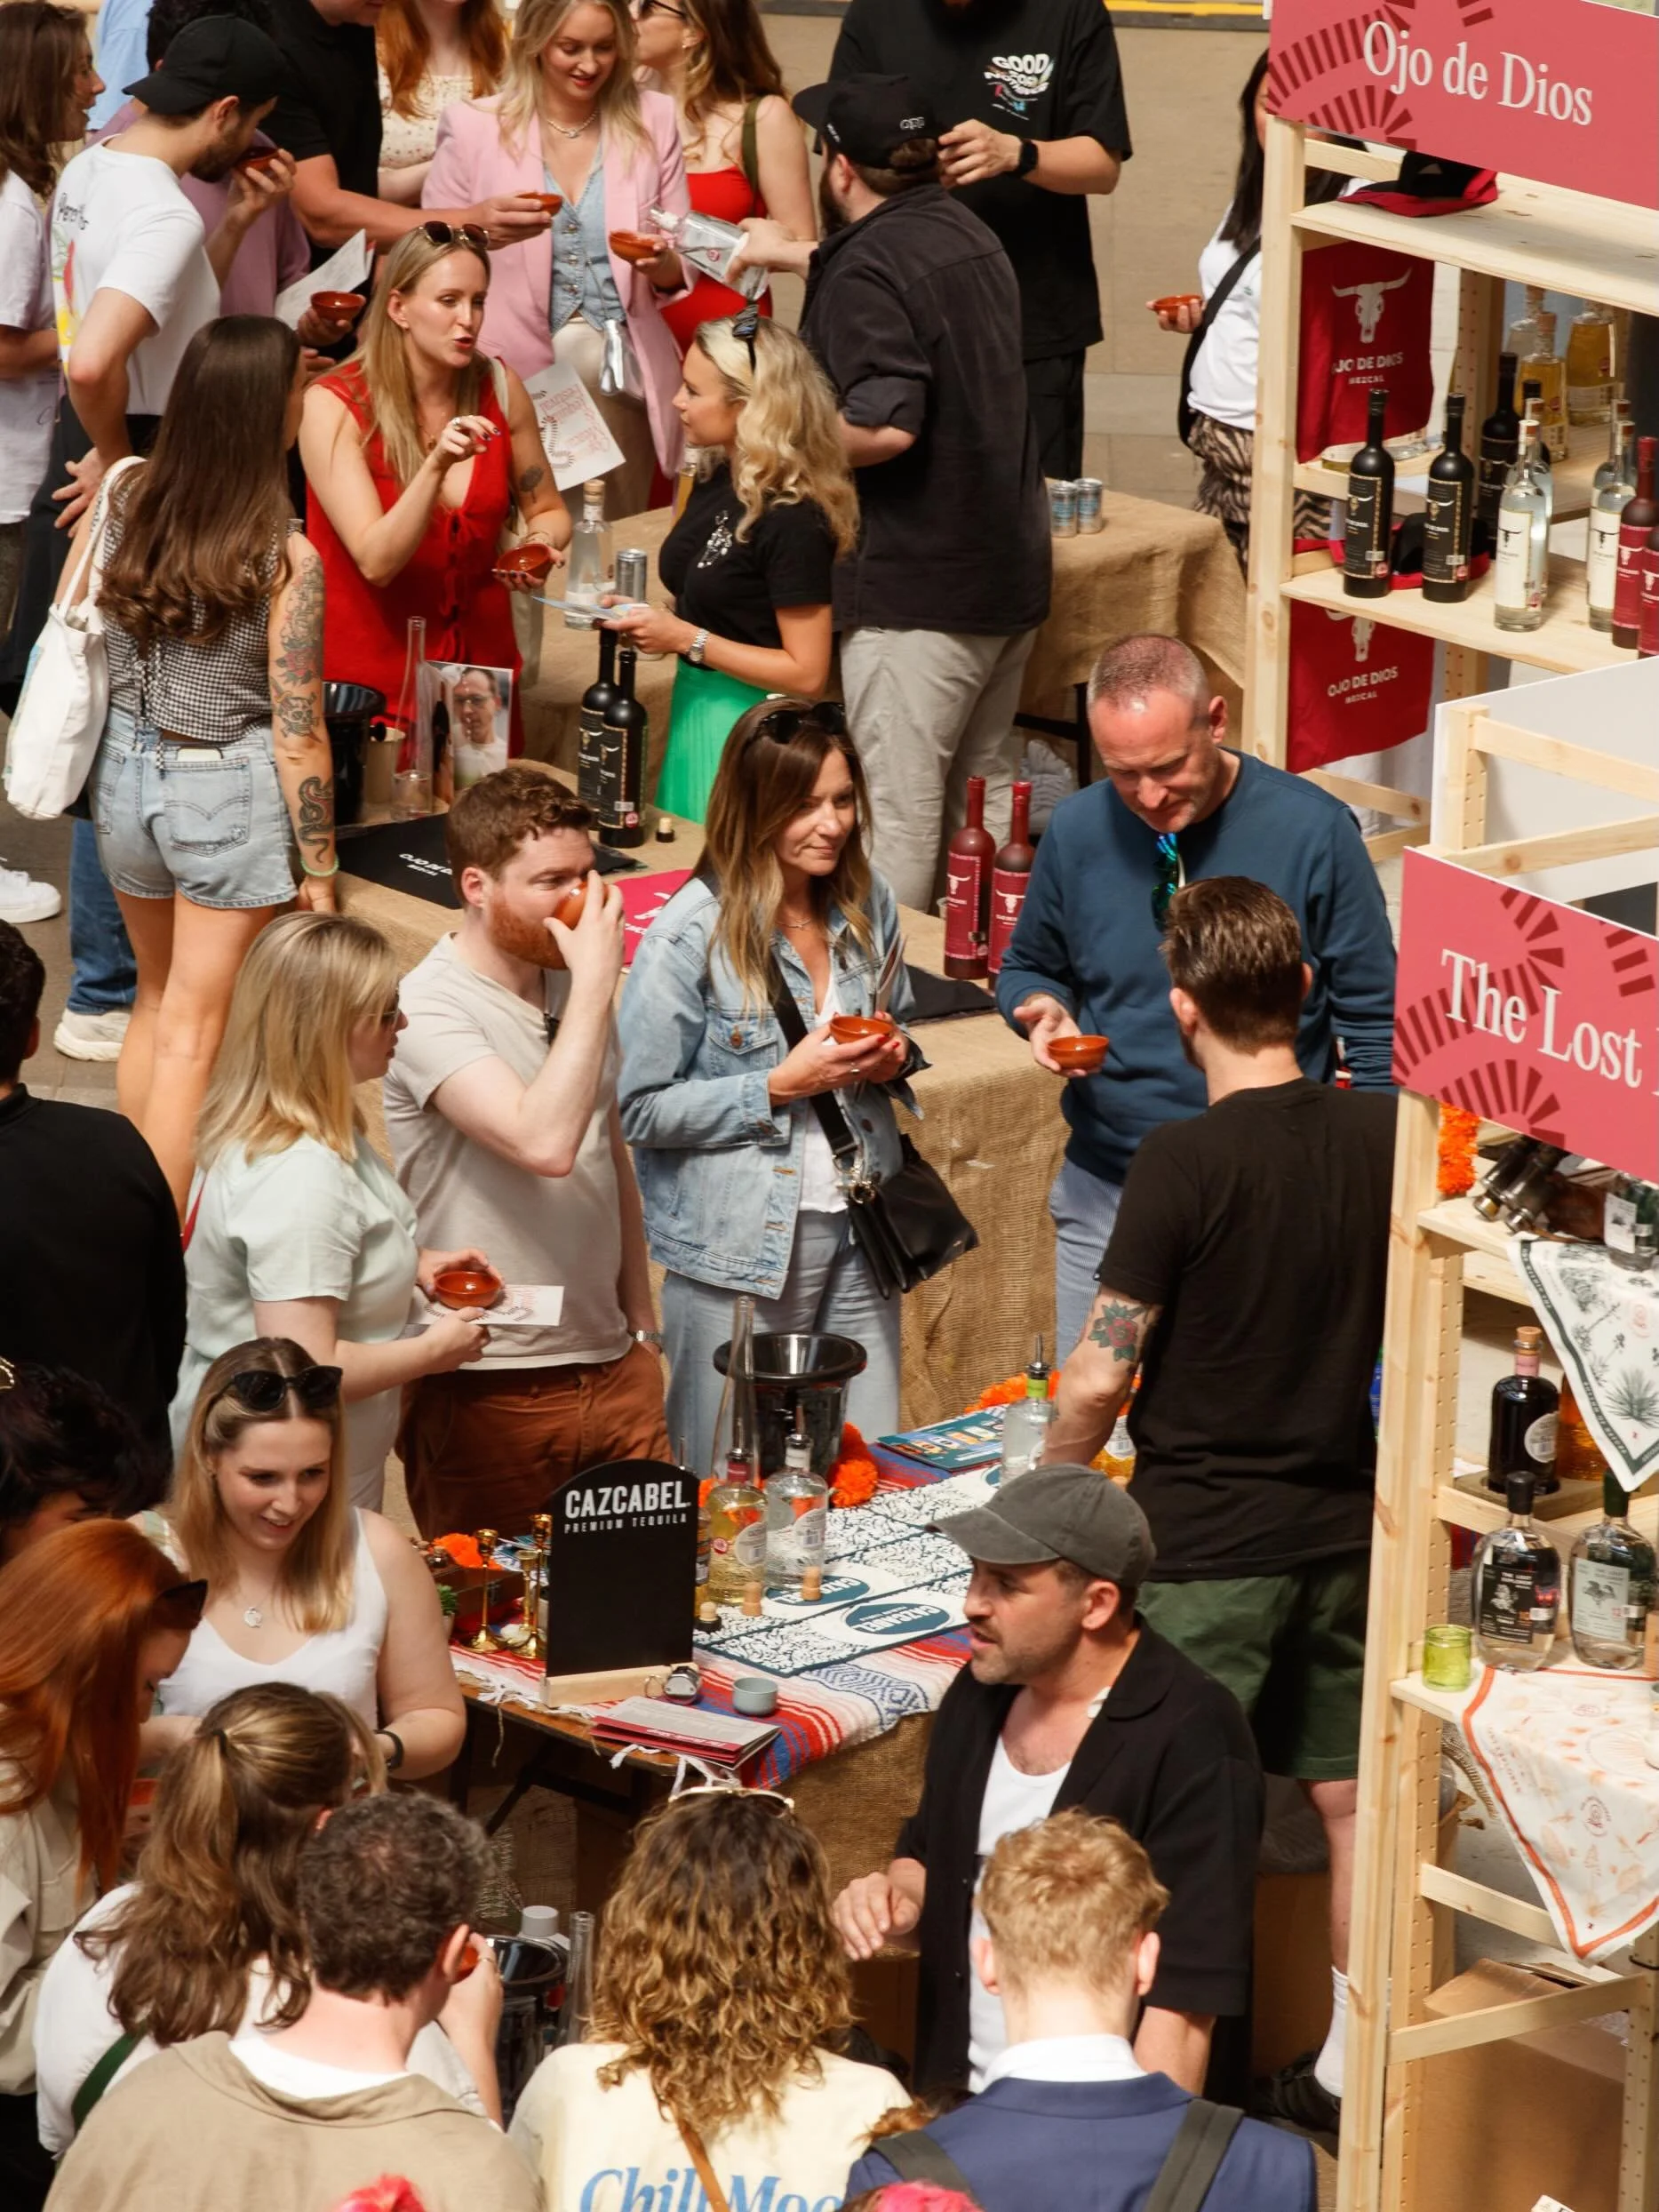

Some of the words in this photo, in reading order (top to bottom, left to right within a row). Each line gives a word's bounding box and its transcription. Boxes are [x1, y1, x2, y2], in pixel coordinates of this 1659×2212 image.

[991, 53, 1050, 75] GOOD
[1363, 20, 1433, 95] Ojo
[1442, 41, 1489, 100] de
[1497, 51, 1593, 126] Dios
[1356, 356, 1376, 371] DE
[1327, 679, 1351, 698] OJO
[1351, 674, 1369, 689] DE
[1369, 666, 1399, 685] DIOS
[1440, 948, 1528, 1044] The
[1536, 985, 1643, 1089] Lost
[565, 1481, 690, 1519] CAZCABEL
[564, 1519, 624, 1535] PREMIUM
[632, 1513, 688, 1528] TEQUILA
